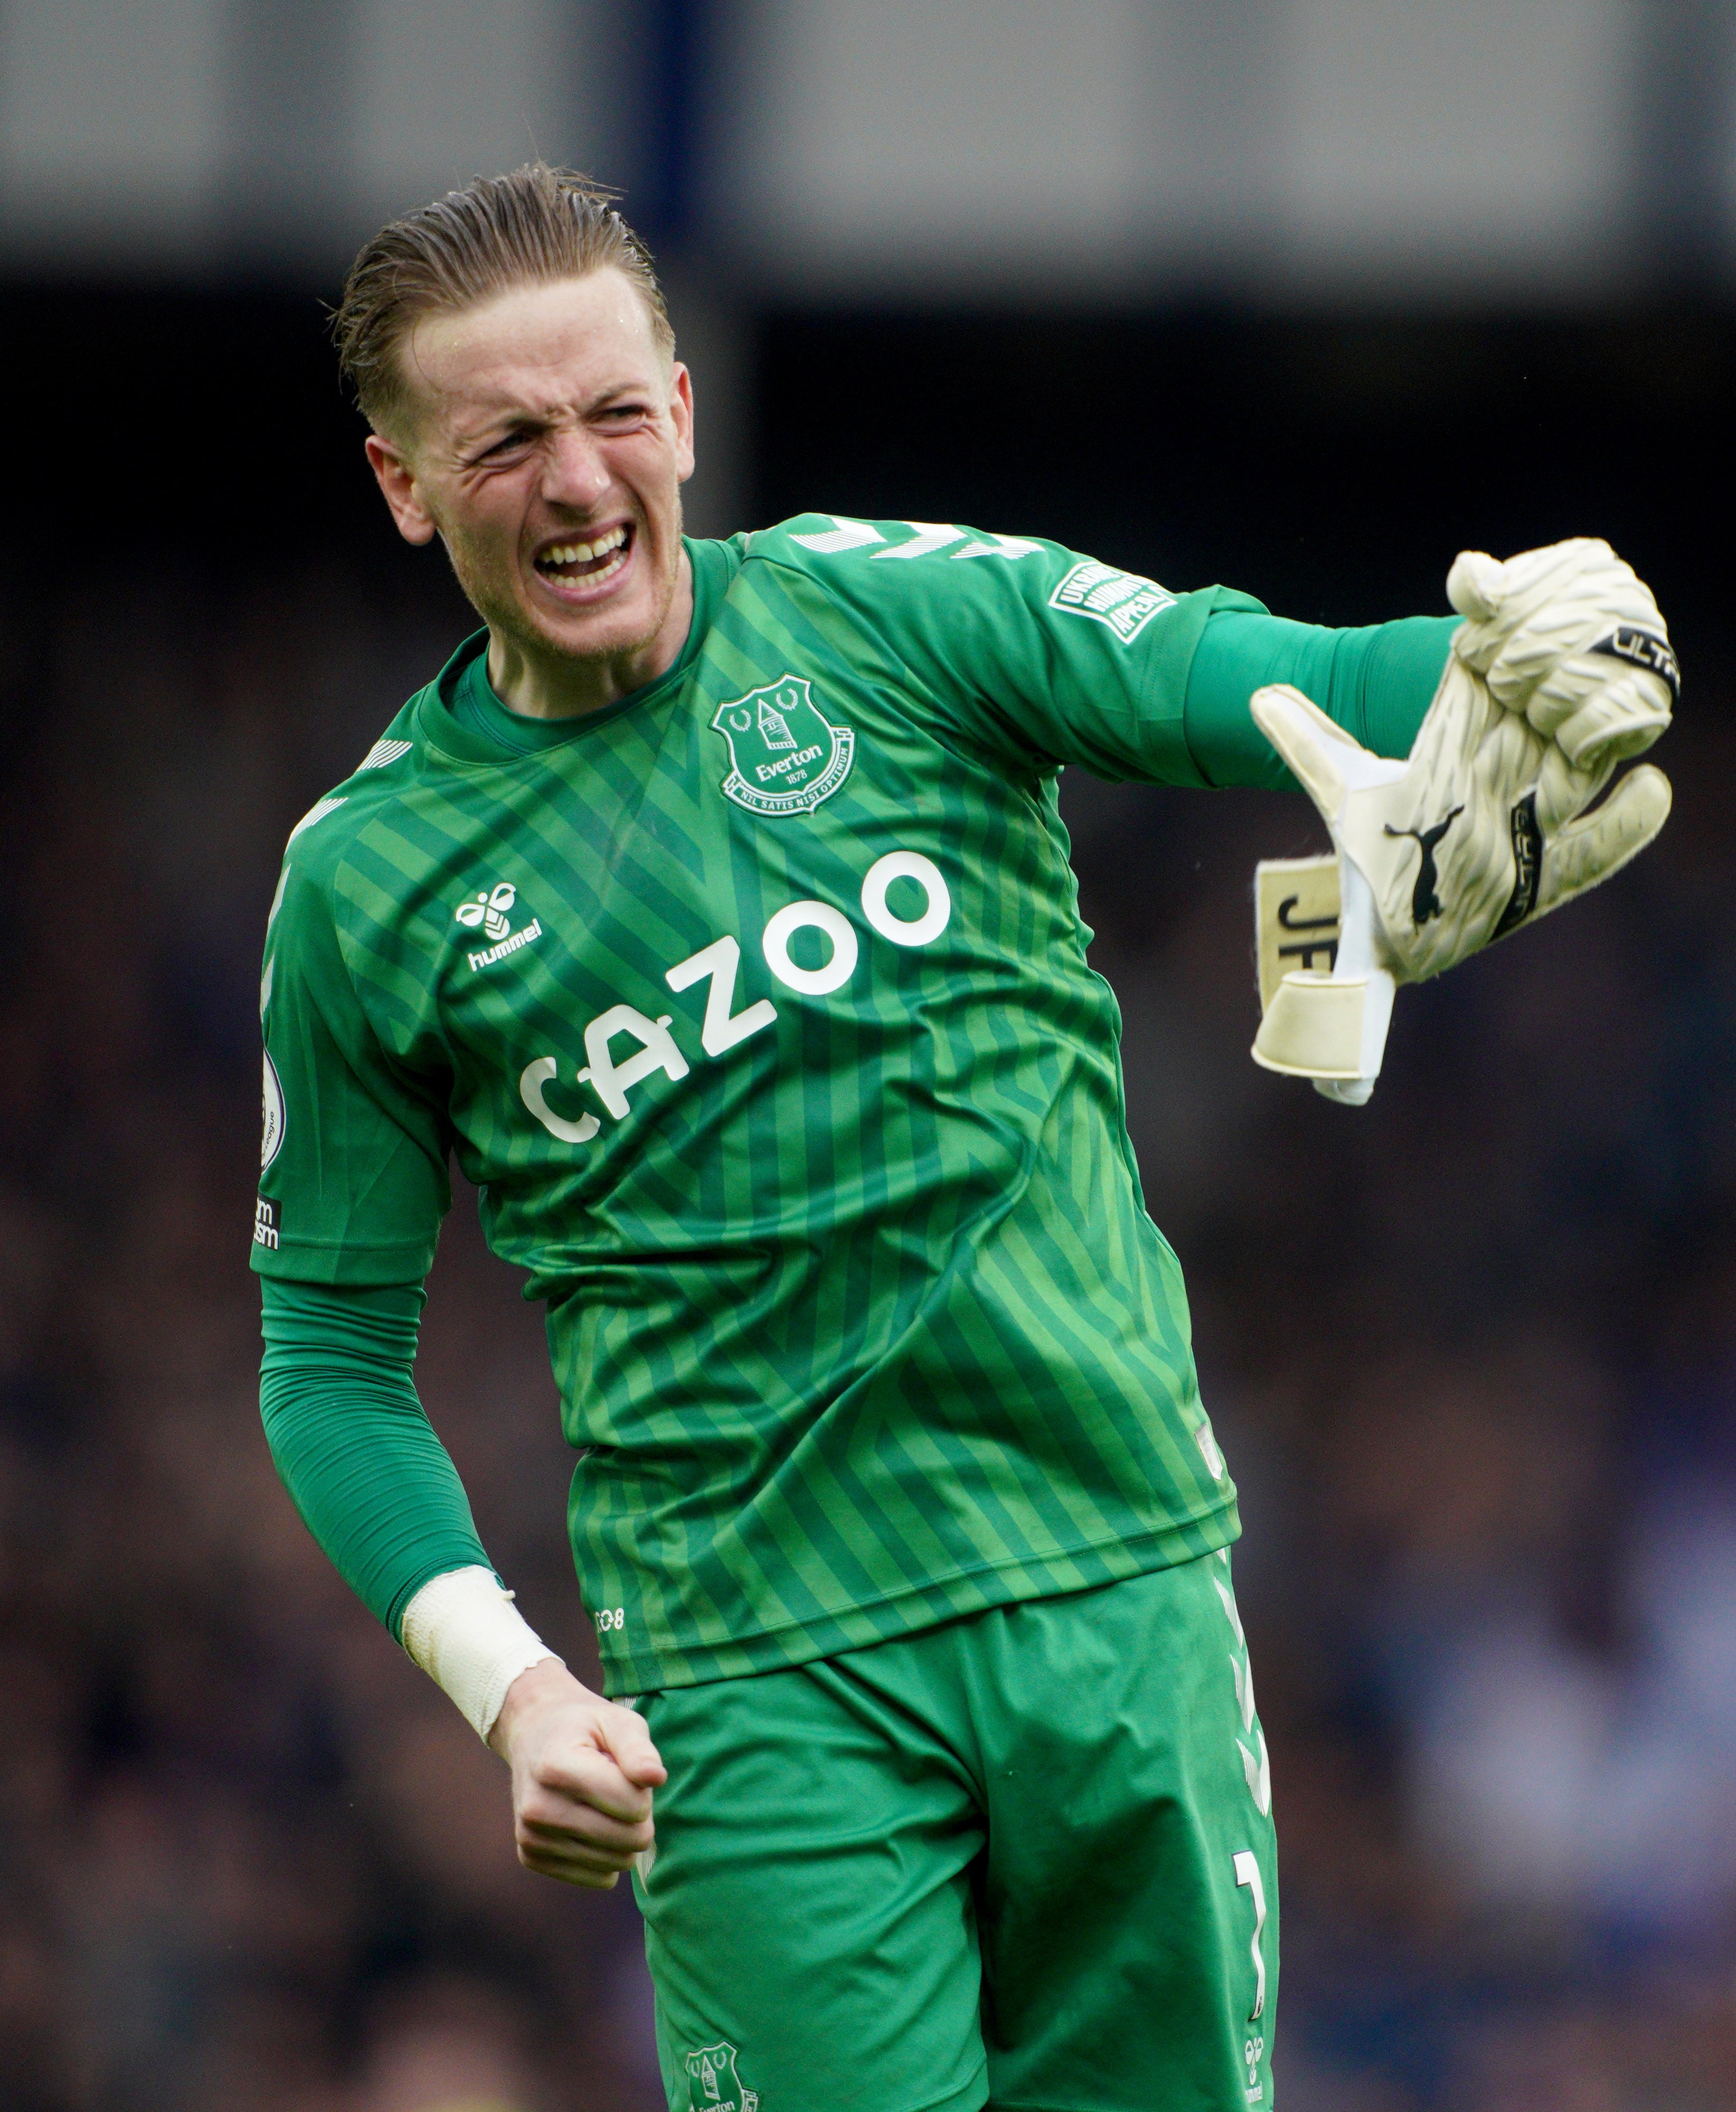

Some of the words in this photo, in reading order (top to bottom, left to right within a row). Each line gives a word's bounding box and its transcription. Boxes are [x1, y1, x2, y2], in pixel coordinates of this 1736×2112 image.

[741, 791, 757, 806] NIL
[761, 800, 794, 810] SATIS
[796, 790, 820, 806] NISI
[820, 747, 848, 792] OPTIMUM
[756, 746, 823, 782] Everton
[786, 769, 807, 785] 1878
[468, 918, 543, 972] hummel
[520, 851, 951, 1143] CAZOO
